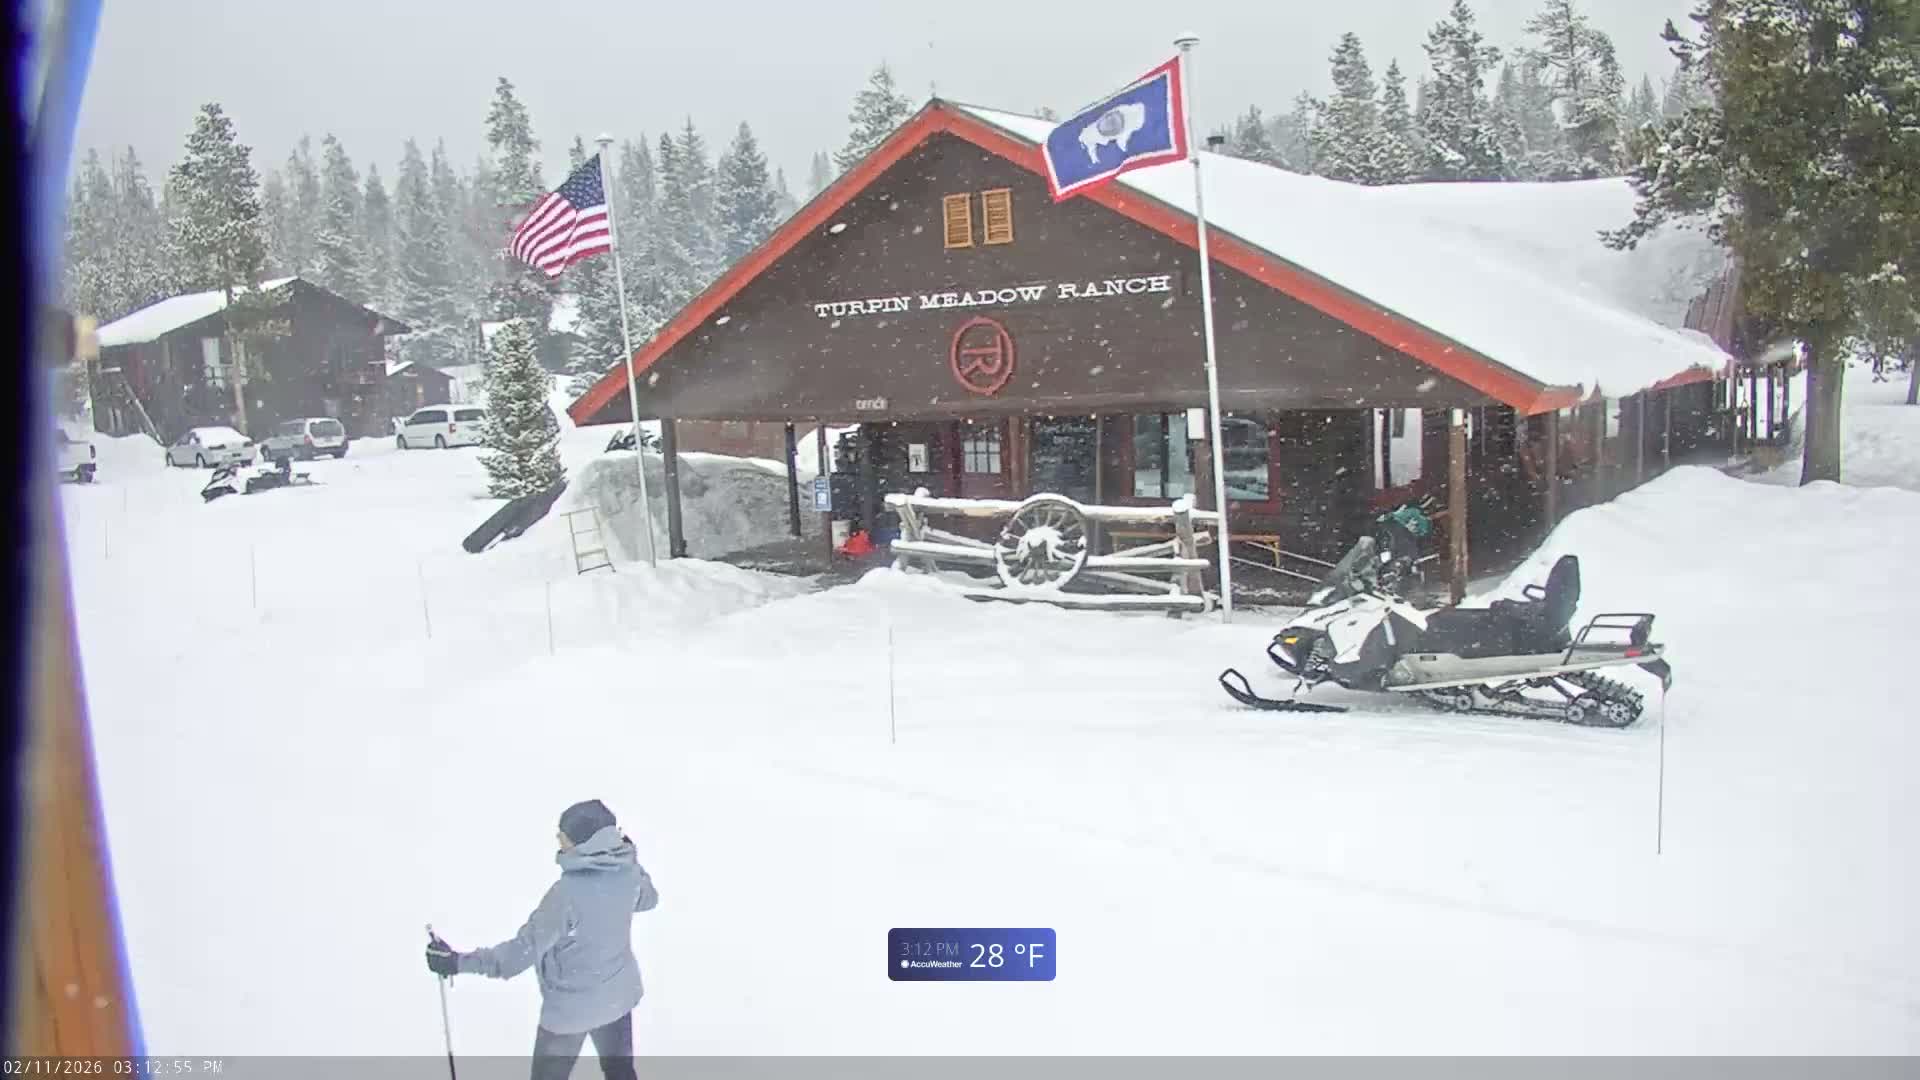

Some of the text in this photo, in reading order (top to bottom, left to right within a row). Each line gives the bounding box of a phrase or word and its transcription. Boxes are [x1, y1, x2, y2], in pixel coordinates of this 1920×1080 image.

[814, 275, 1173, 318] TURPIN MEADOW RANCH
